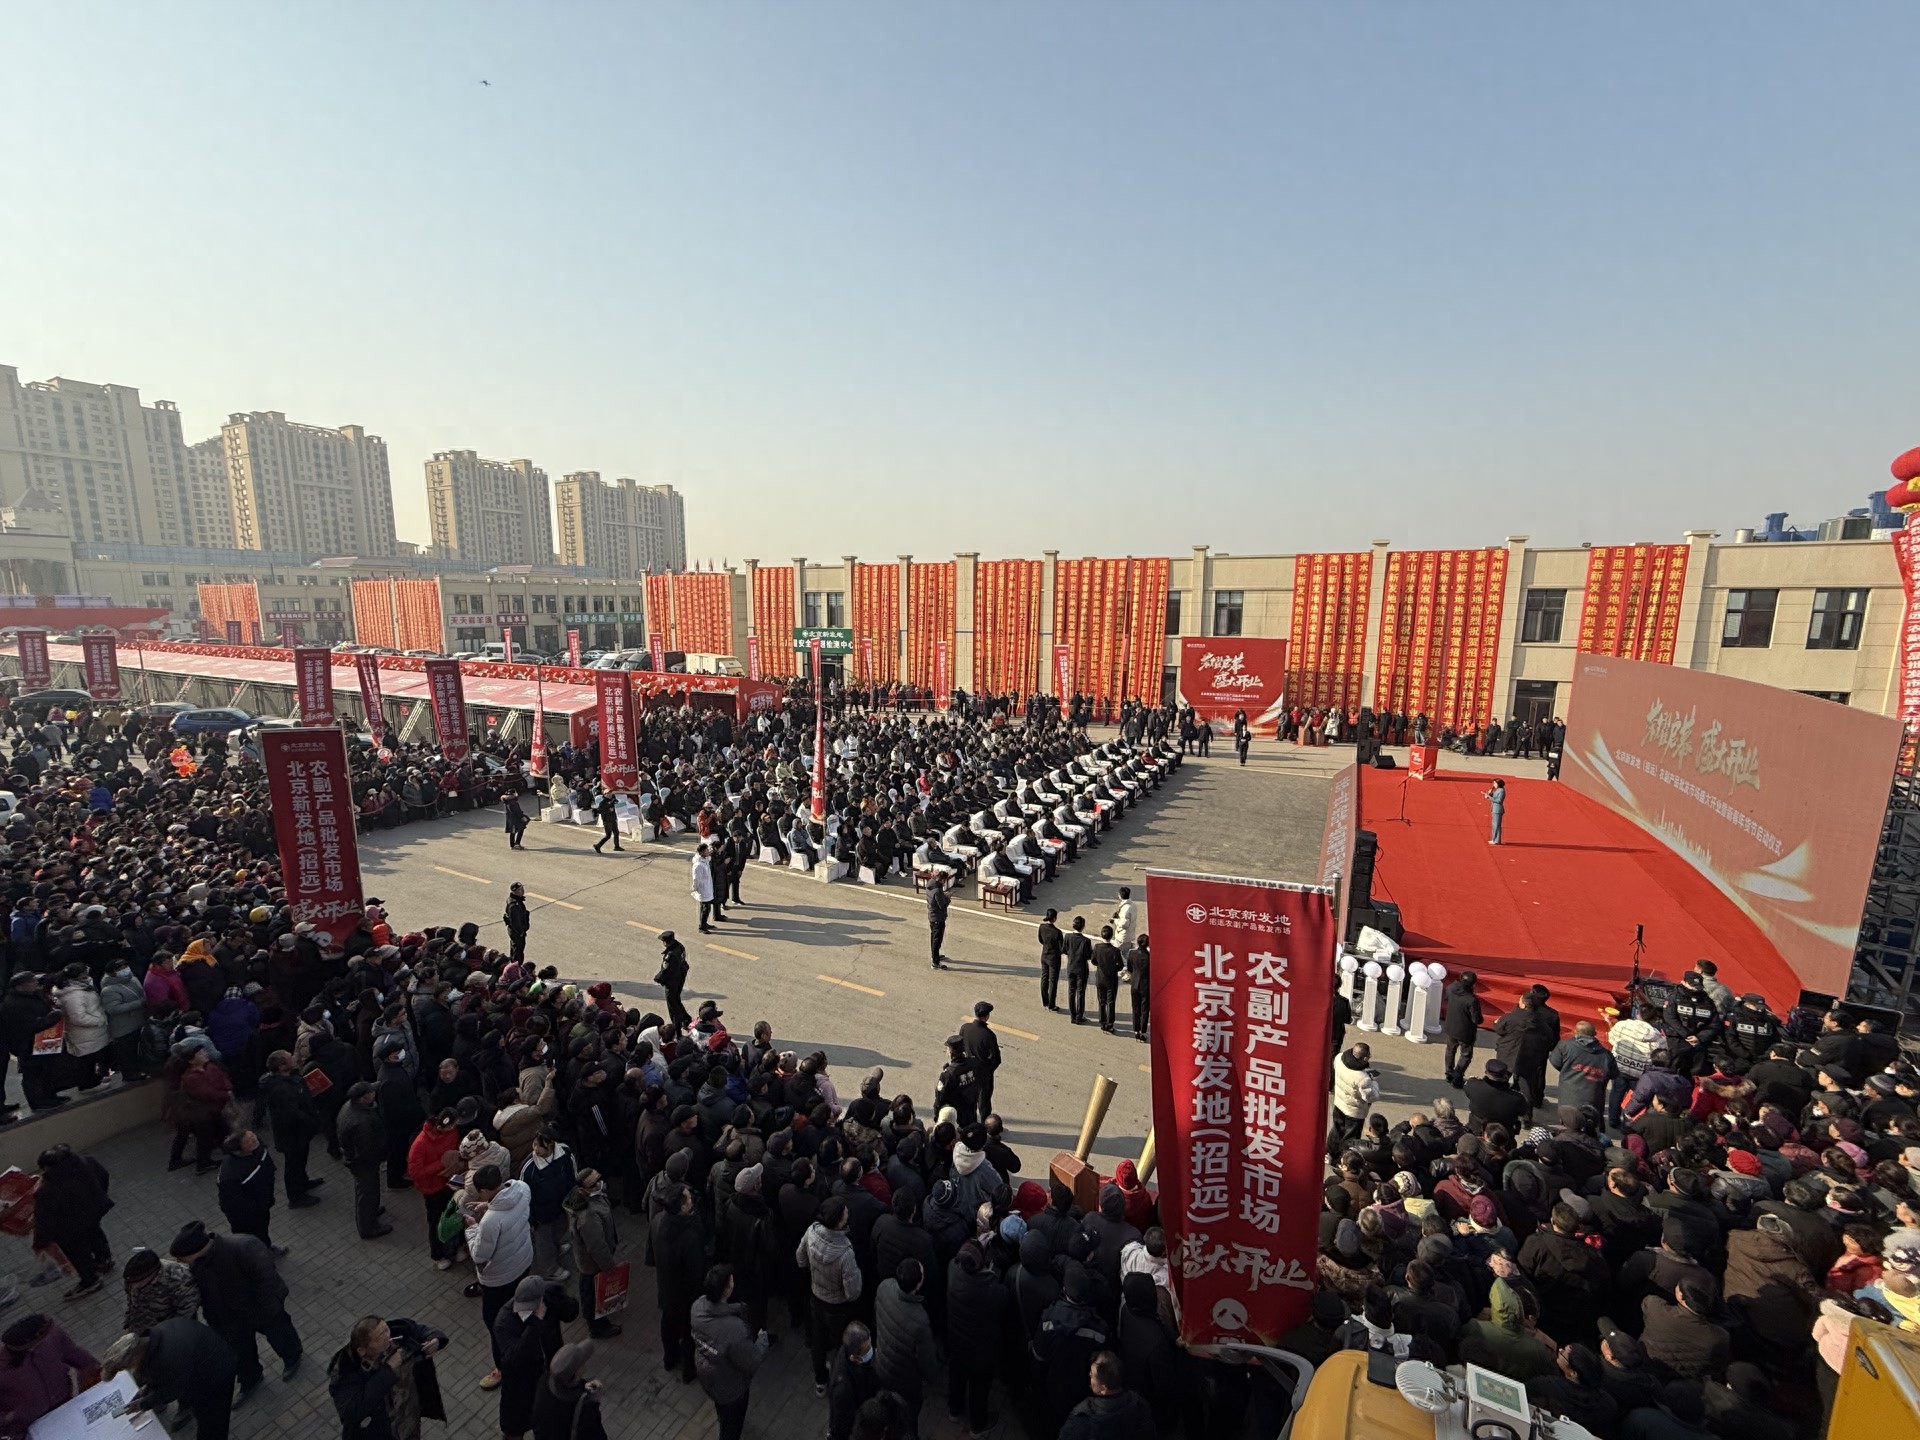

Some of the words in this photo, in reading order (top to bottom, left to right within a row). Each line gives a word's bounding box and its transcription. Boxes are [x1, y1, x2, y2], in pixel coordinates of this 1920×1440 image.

[1581, 548, 1606, 654] 泗县新发地热烈祝贺
[309, 760, 343, 892] 农副产品批发市场
[1209, 906, 1291, 926] 北京新发地
[1209, 918, 1291, 935] 招远农副产品批发市场
[1238, 951, 1291, 1233] 农副产品批发市场
[1171, 1232, 1314, 1291] 盛大开业
